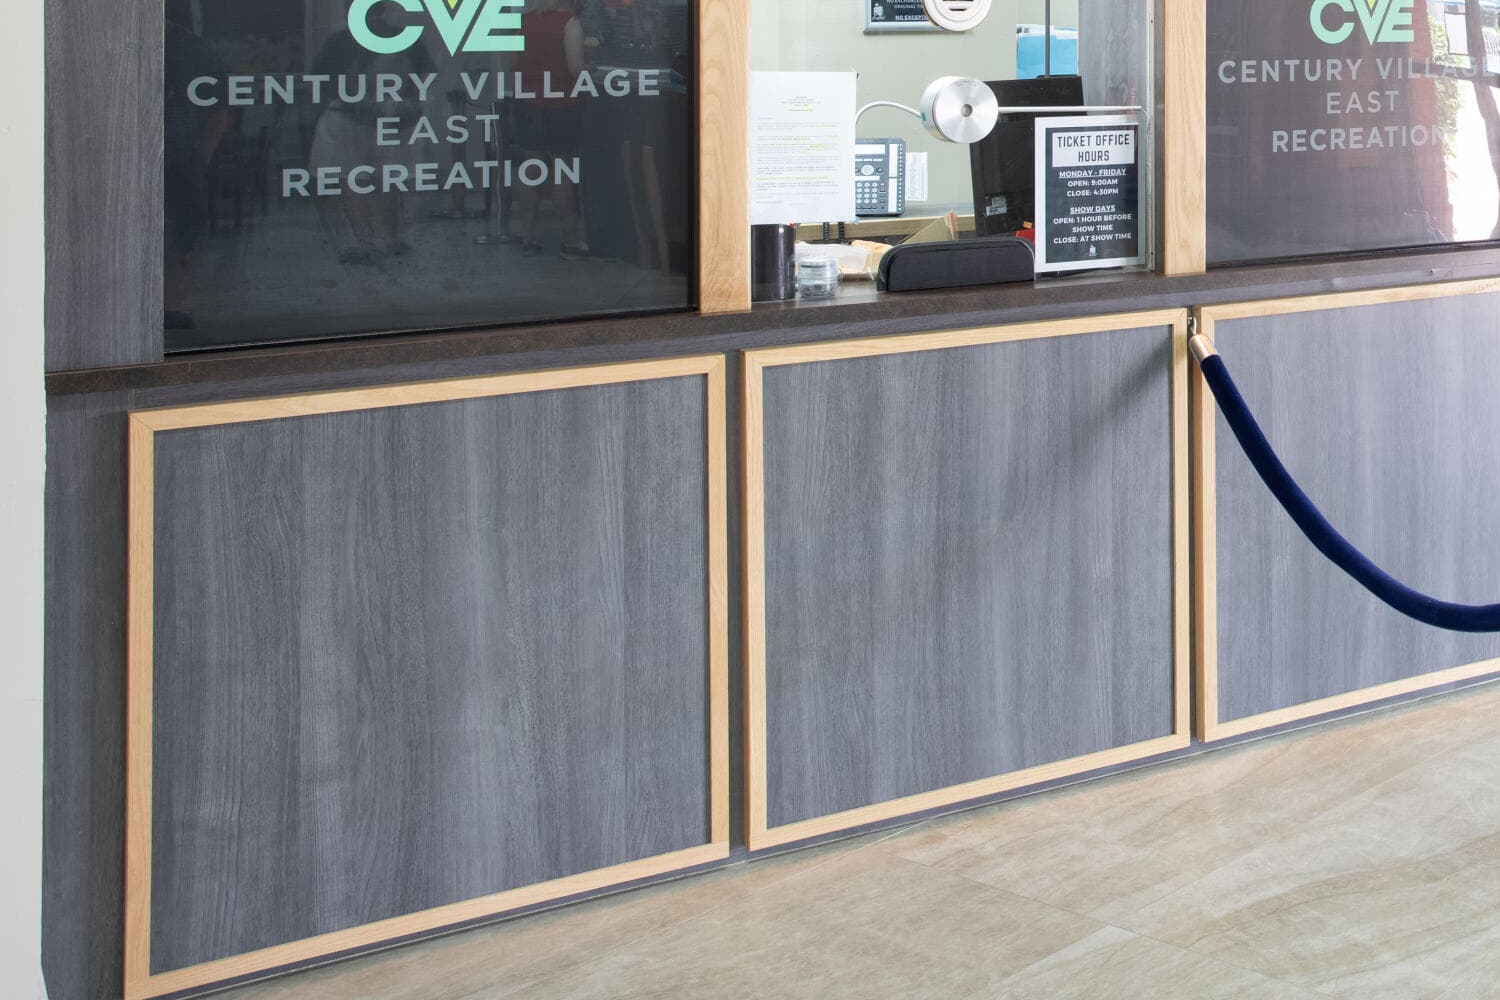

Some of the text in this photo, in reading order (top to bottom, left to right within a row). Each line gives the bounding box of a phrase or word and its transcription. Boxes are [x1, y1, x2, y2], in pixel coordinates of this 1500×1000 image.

[1218, 58, 1363, 84] CENTURY
[187, 68, 661, 107] CENTURY VILLAGE
[1326, 90, 1400, 115] EAST
[376, 114, 501, 147] EAST
[1058, 134, 1130, 148] TICKET OFFICE
[1078, 150, 1110, 162] HOURS
[282, 157, 581, 197] RECREATION
[1059, 168, 1127, 178] MONDAY FRIDAY
[1070, 206, 1094, 214] SHOW
